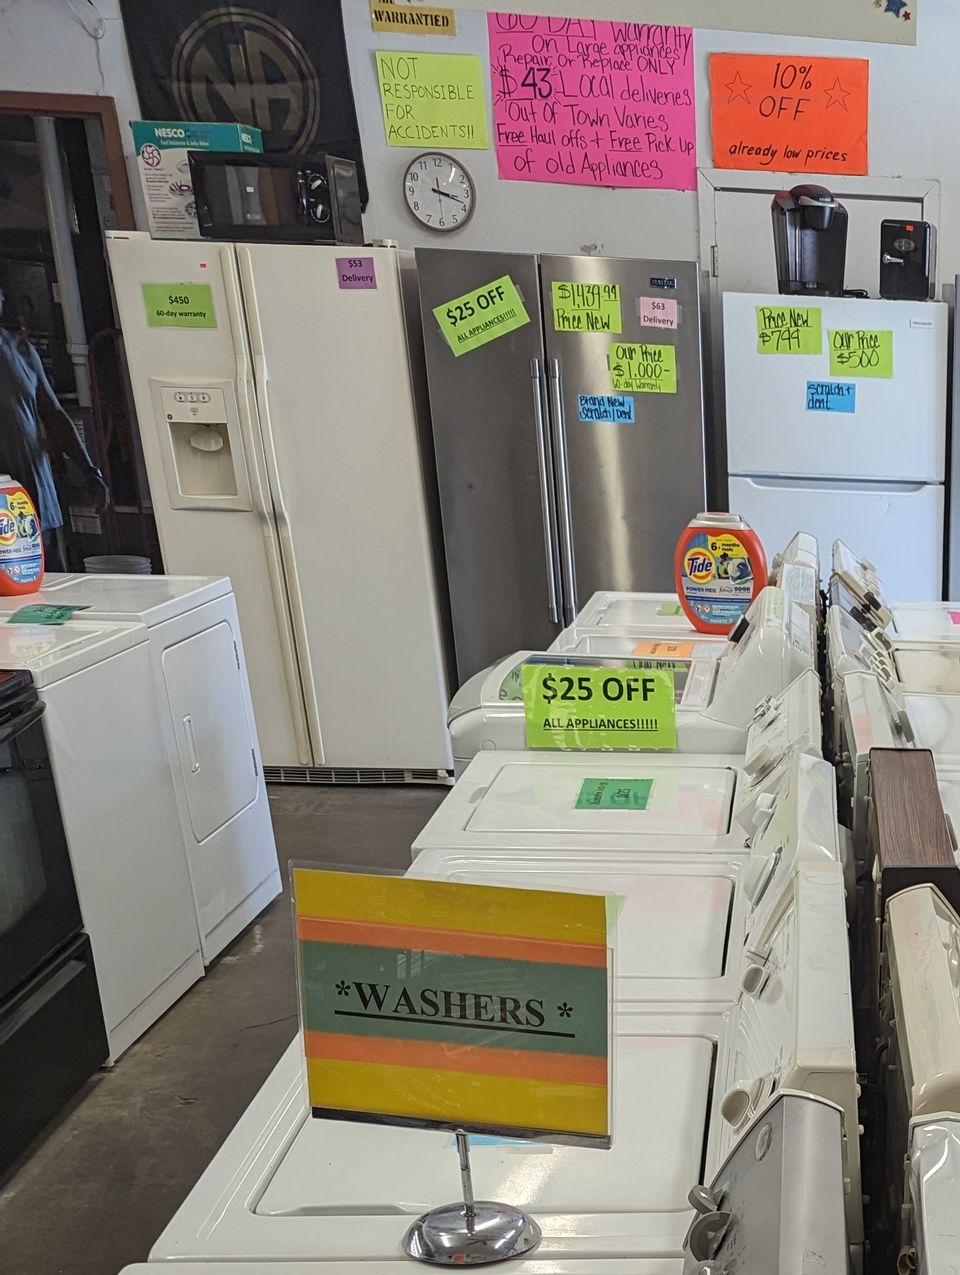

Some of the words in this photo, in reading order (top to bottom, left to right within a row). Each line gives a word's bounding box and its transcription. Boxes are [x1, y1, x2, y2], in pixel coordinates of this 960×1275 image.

[374, 9, 449, 28] WARRANTIED
[532, 35, 558, 53] On
[567, 36, 607, 57] Large
[614, 43, 680, 61] appliances
[500, 44, 551, 70] Repair
[558, 53, 575, 68] Or
[578, 54, 632, 75] Replace
[637, 58, 675, 75] ONLY
[380, 57, 418, 80] NOT
[773, 62, 813, 90] 10%
[384, 84, 475, 100] RESPONSIBLE
[621, 75, 692, 106] deliveries
[386, 103, 415, 120] FOR
[759, 95, 811, 121] OFF
[508, 101, 537, 122] Out
[563, 104, 610, 128] Town
[614, 105, 669, 132] Varies
[155, 128, 185, 138] NESCO
[388, 125, 475, 140] ACCIDENTS!!
[497, 123, 528, 145] Free
[530, 126, 556, 146] Haul
[562, 129, 588, 149] offs
[610, 131, 643, 151] Free
[645, 132, 672, 152] Pick
[679, 137, 694, 156] Up
[729, 141, 778, 166] already
[783, 145, 800, 159] low
[806, 147, 848, 167] prices
[419, 161, 427, 170] 11
[433, 158, 442, 168] 12
[514, 148, 535, 173] of
[546, 151, 575, 175] old
[581, 152, 664, 181] Appliances
[410, 172, 418, 182] 10
[460, 175, 465, 184] 2
[409, 187, 414, 196] 9
[464, 189, 469, 198] 3
[414, 202, 419, 211] 8
[461, 203, 467, 212] 4
[426, 215, 432, 223] 7
[439, 218, 445, 227] 6
[452, 216, 458, 224] 5
[348, 259, 363, 270] $53
[342, 273, 374, 284] Delivery
[168, 295, 190, 306] $450
[446, 301, 477, 327] $25
[476, 285, 506, 311] OFF
[651, 301, 665, 311] $63
[156, 309, 178, 320] 60-day
[179, 310, 207, 321] warranty
[557, 308, 582, 330] Price
[586, 312, 610, 331] New
[643, 315, 675, 327] Delivery
[760, 307, 787, 329] Price
[789, 309, 811, 328] New
[457, 332, 470, 344] ALL
[759, 328, 801, 351] $799
[833, 331, 852, 349] Our
[858, 331, 880, 349] Price
[616, 345, 637, 360] Our
[640, 345, 664, 363] Price
[836, 350, 880, 368] $500
[580, 396, 605, 407] Brand
[608, 396, 626, 407] New
[808, 396, 834, 410] dent
[688, 557, 712, 576] Tide
[542, 673, 593, 704] $25
[602, 678, 655, 701] OFF
[543, 718, 563, 730] ALL
